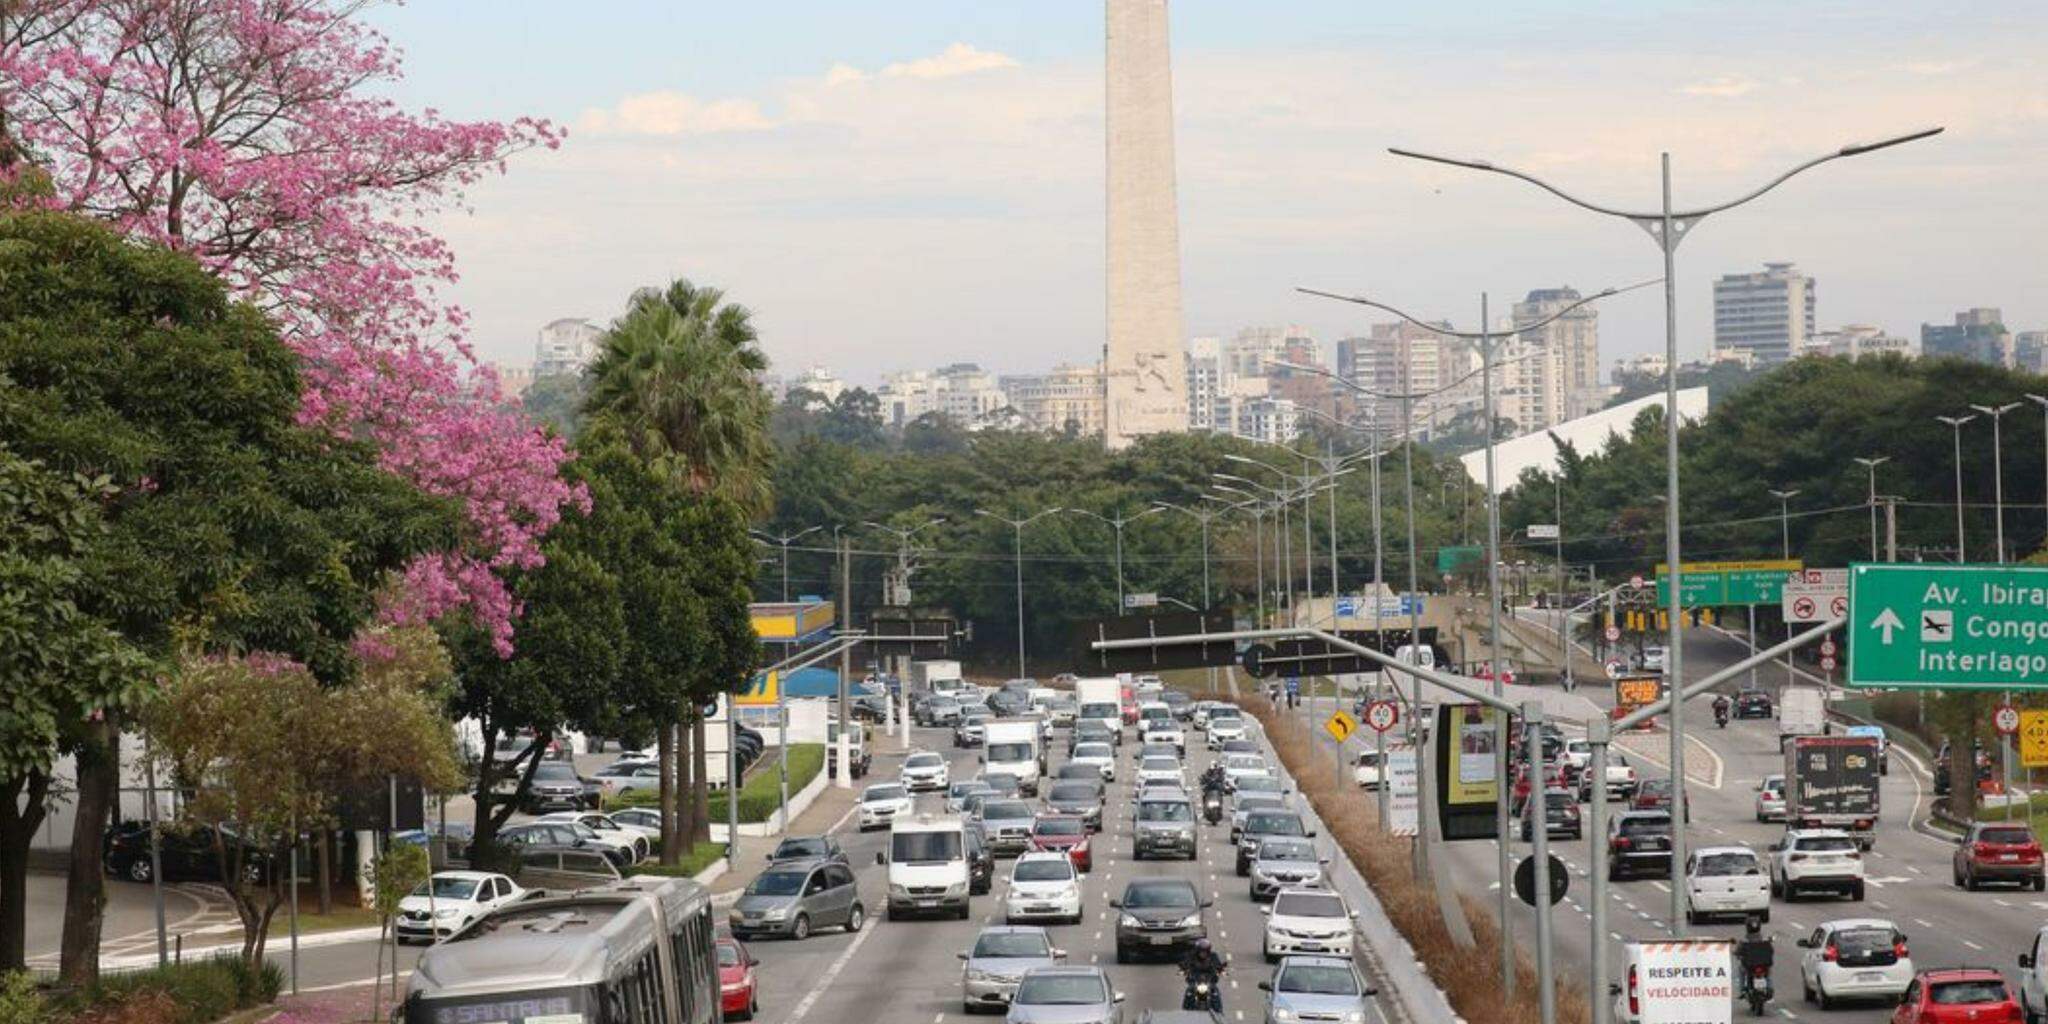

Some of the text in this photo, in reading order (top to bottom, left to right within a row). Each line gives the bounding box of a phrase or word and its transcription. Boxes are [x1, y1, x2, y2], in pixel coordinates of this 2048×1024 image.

[1923, 581, 2048, 609] Av. Ibira
[1966, 615, 2048, 645] Congo
[1919, 648, 2047, 678] Interlago
[1375, 707, 1389, 718] 40
[2001, 712, 2015, 721] 40
[1648, 966, 1727, 978] RESPEITE A
[1646, 985, 1729, 998] VELOCIDADE
